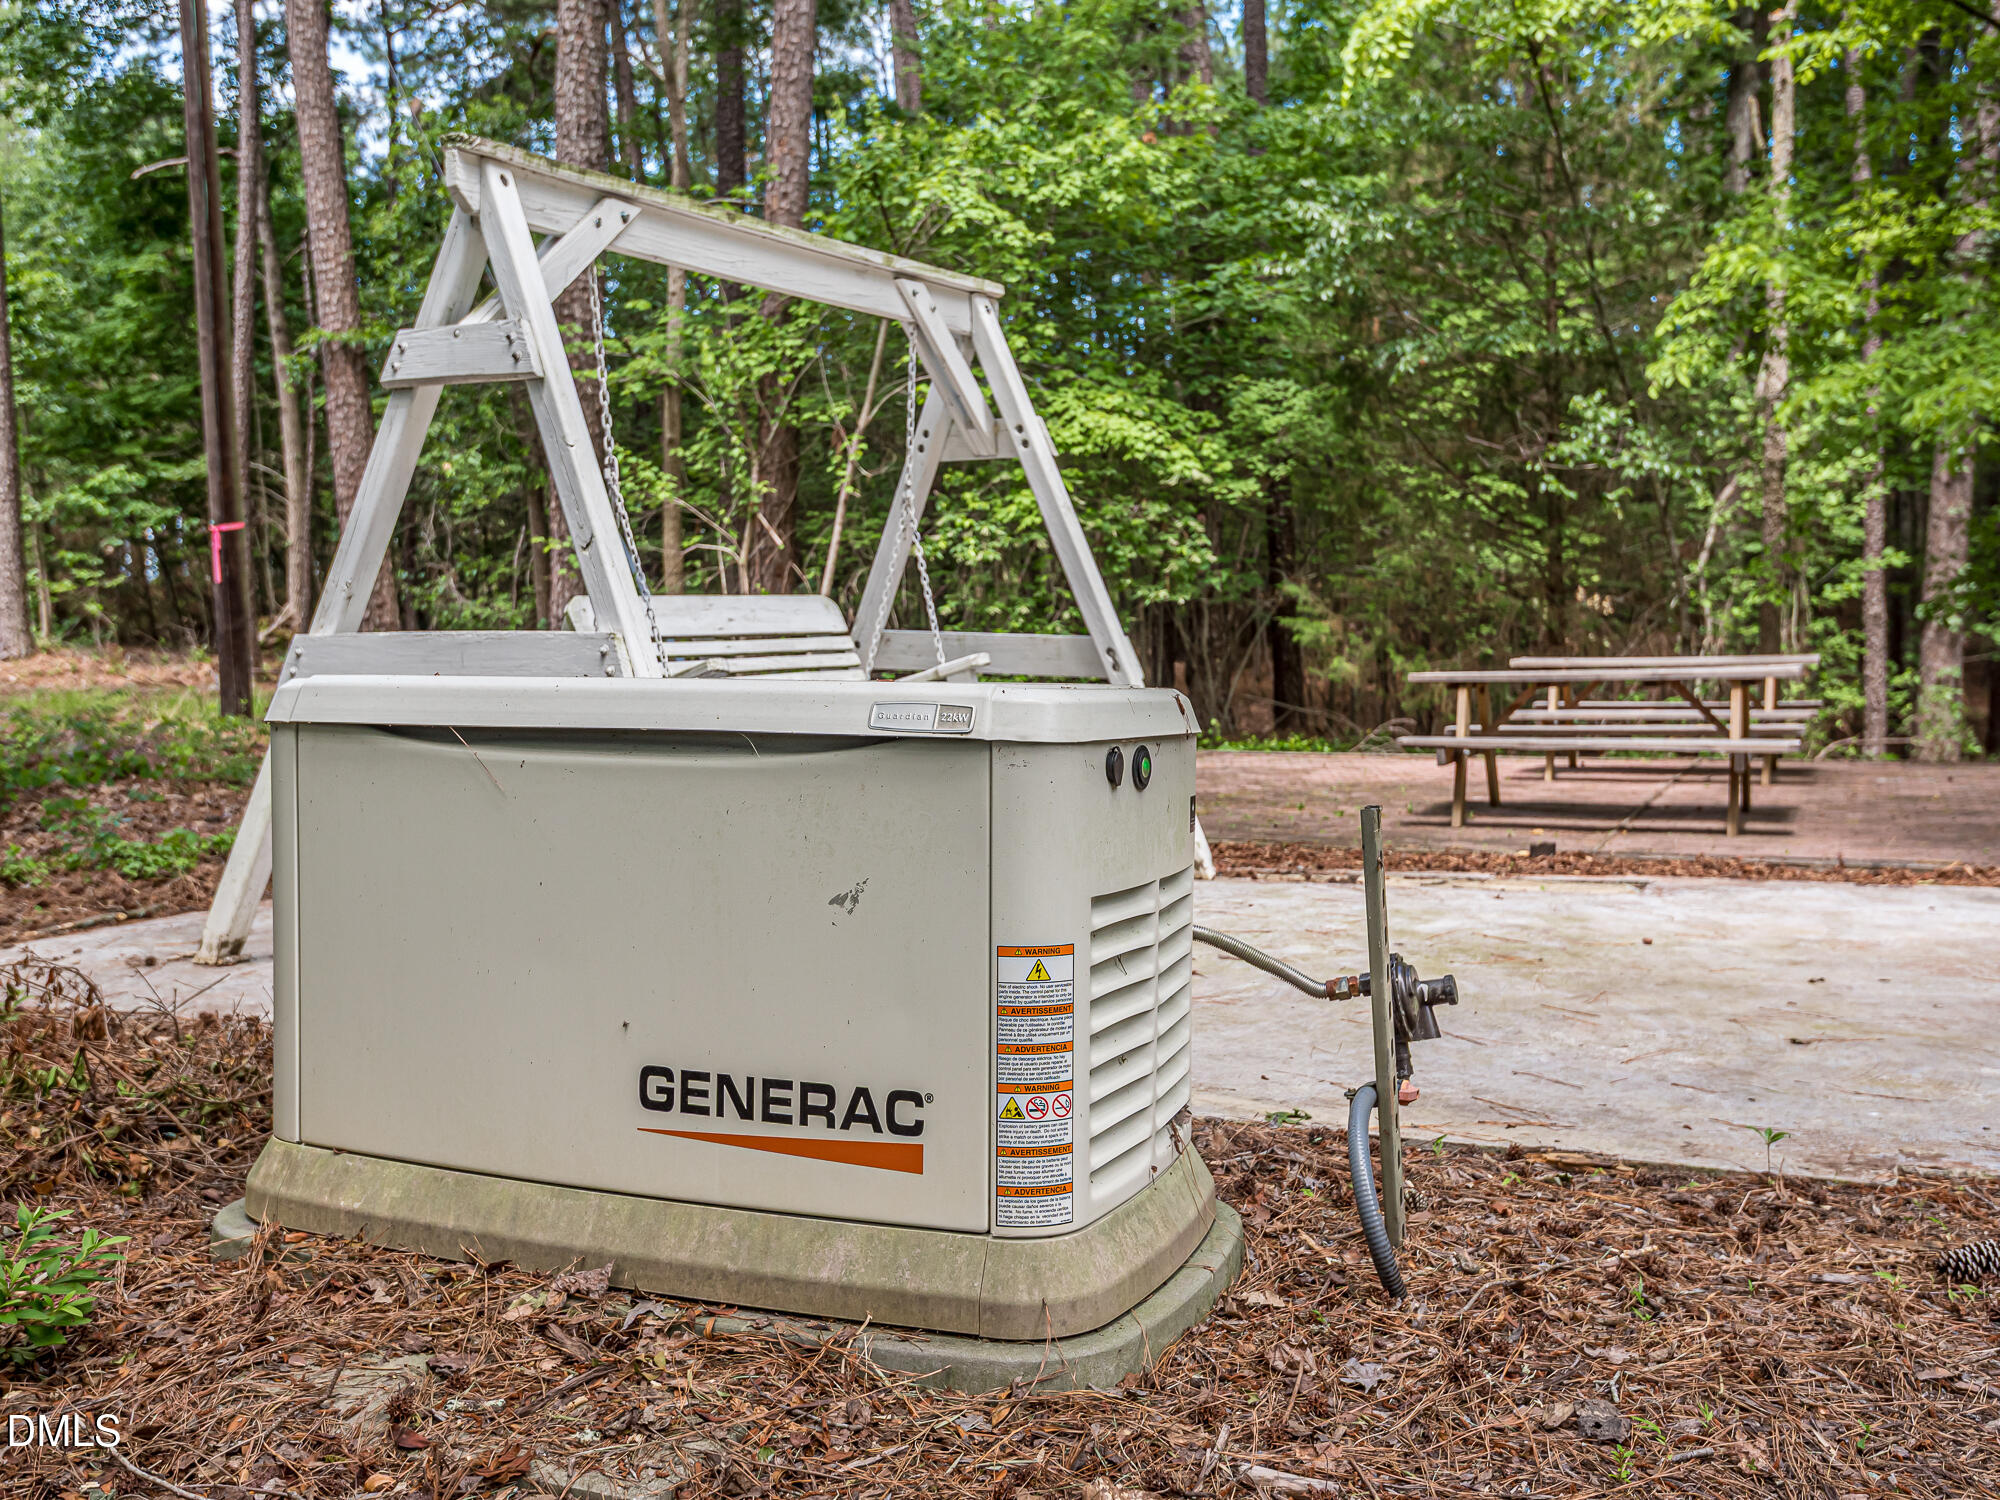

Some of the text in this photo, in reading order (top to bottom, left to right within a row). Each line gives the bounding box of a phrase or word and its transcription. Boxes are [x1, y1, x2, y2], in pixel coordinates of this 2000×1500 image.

[877, 712, 970, 723] Guardian 22kW
[1025, 948, 1061, 956] WARNING
[1011, 1005, 1071, 1014] AVERTISSEMENT
[1015, 1044, 1067, 1052] ADVERTENCIA
[639, 1065, 925, 1137] GENERAC
[1010, 1146, 1071, 1155] AVERTISSEMENT
[1015, 1186, 1067, 1195] ADVERTENCIA
